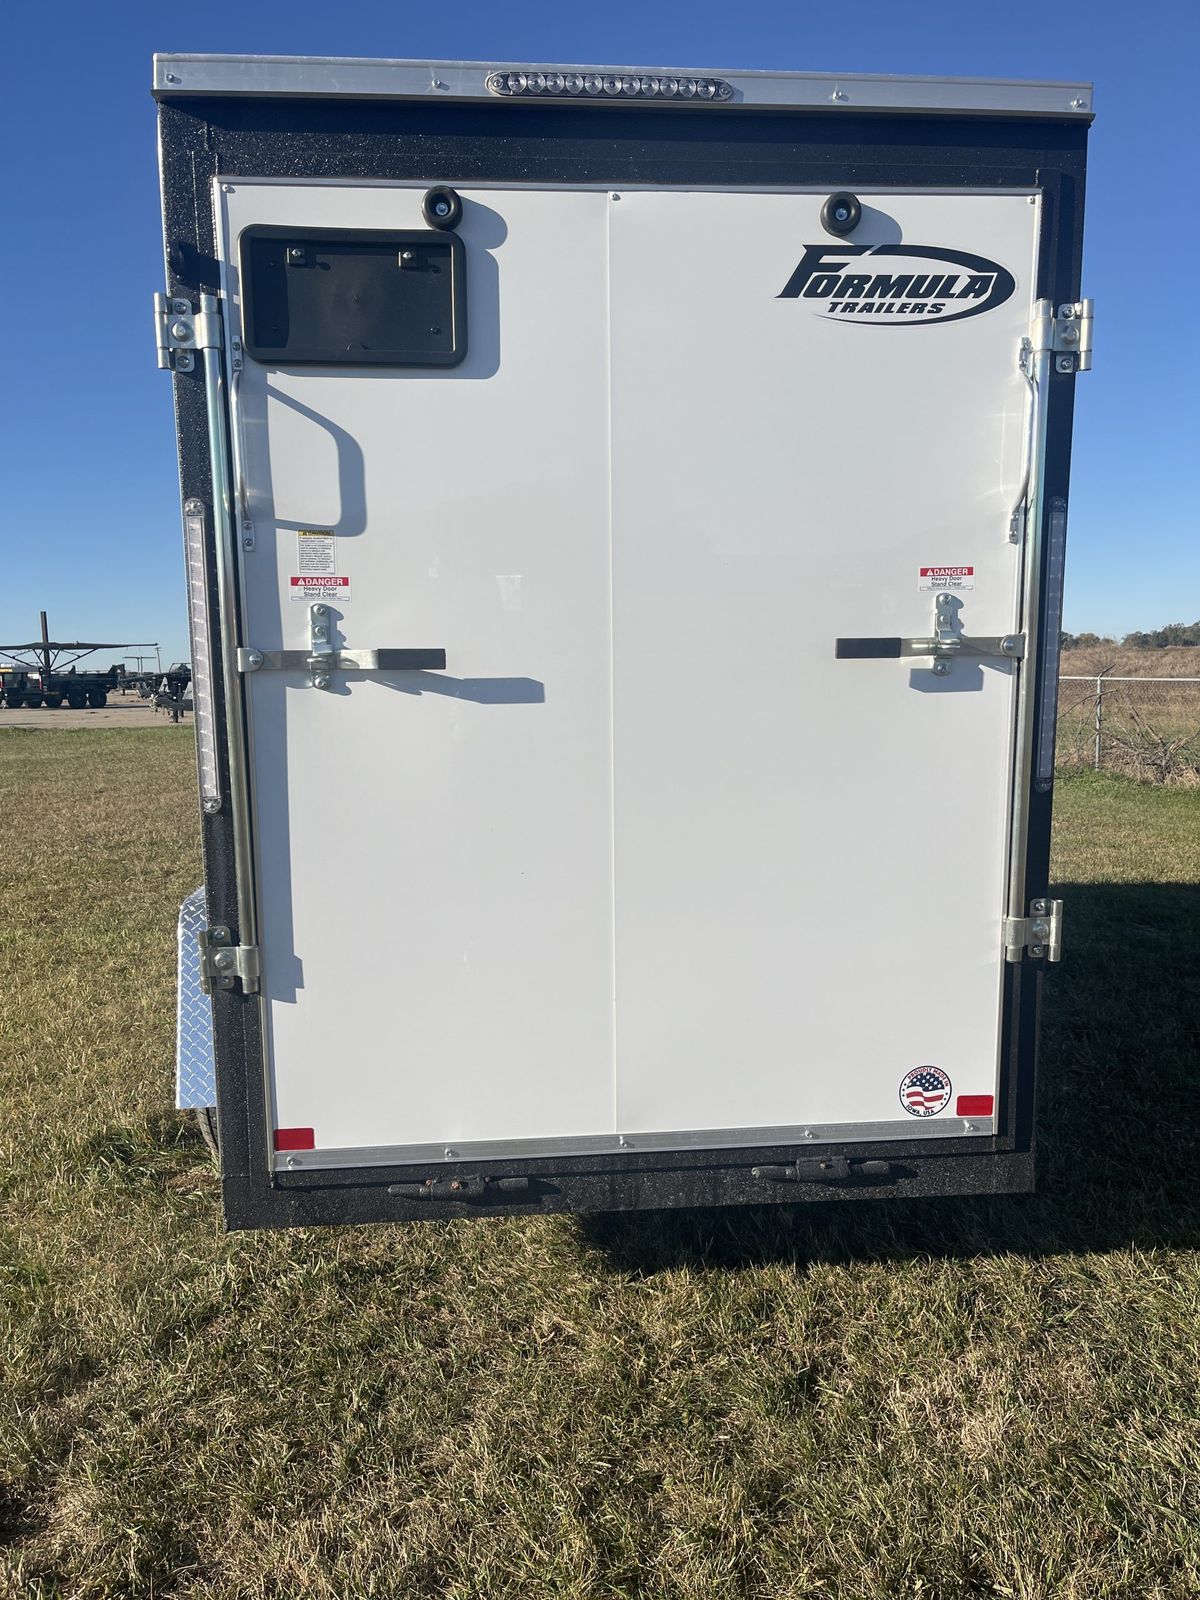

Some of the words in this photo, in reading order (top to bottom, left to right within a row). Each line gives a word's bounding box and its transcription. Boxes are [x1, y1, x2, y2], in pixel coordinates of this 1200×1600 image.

[775, 245, 997, 298] FORMULA
[827, 302, 945, 313] TRAILERS
[305, 578, 343, 586] DANGER
[907, 1068, 932, 1080] PROUDLY
[933, 1069, 947, 1080] MADE
